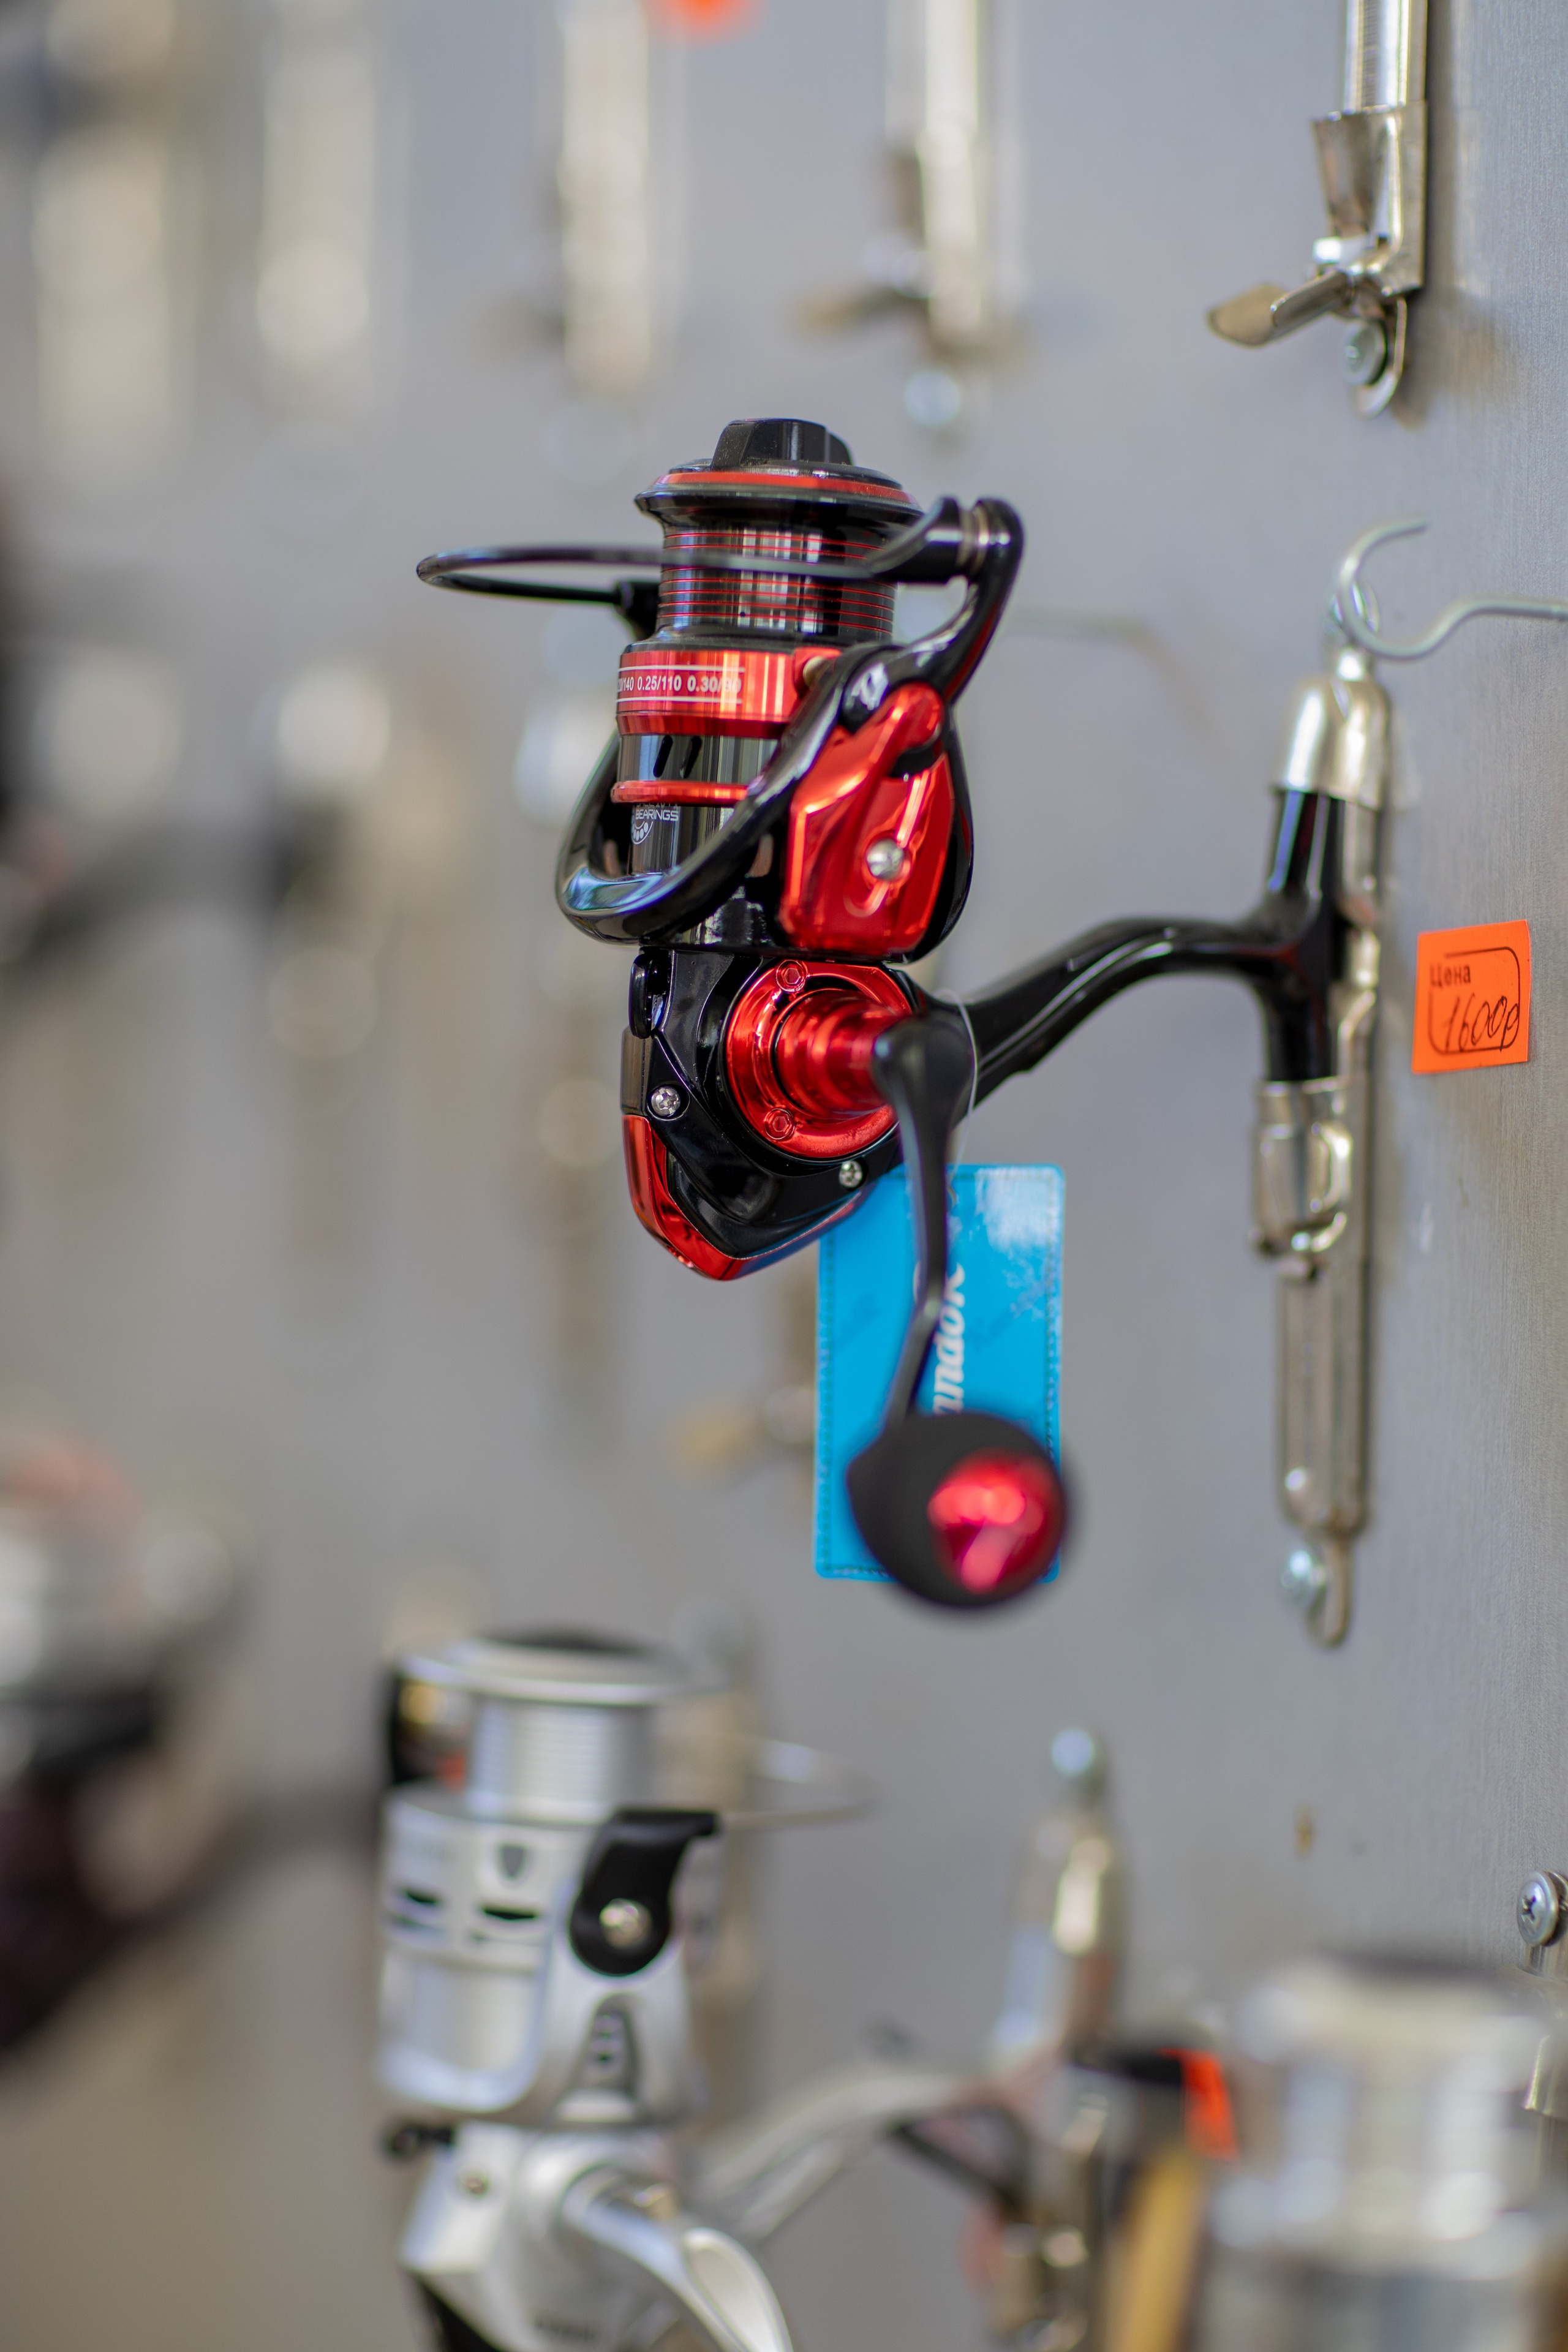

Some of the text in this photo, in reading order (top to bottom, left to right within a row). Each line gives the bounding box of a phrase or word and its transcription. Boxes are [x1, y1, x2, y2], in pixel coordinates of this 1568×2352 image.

[638, 674, 682, 692] 0.25/110
[635, 809, 679, 821] BEARINGS
[1430, 964, 1471, 989] Цена
